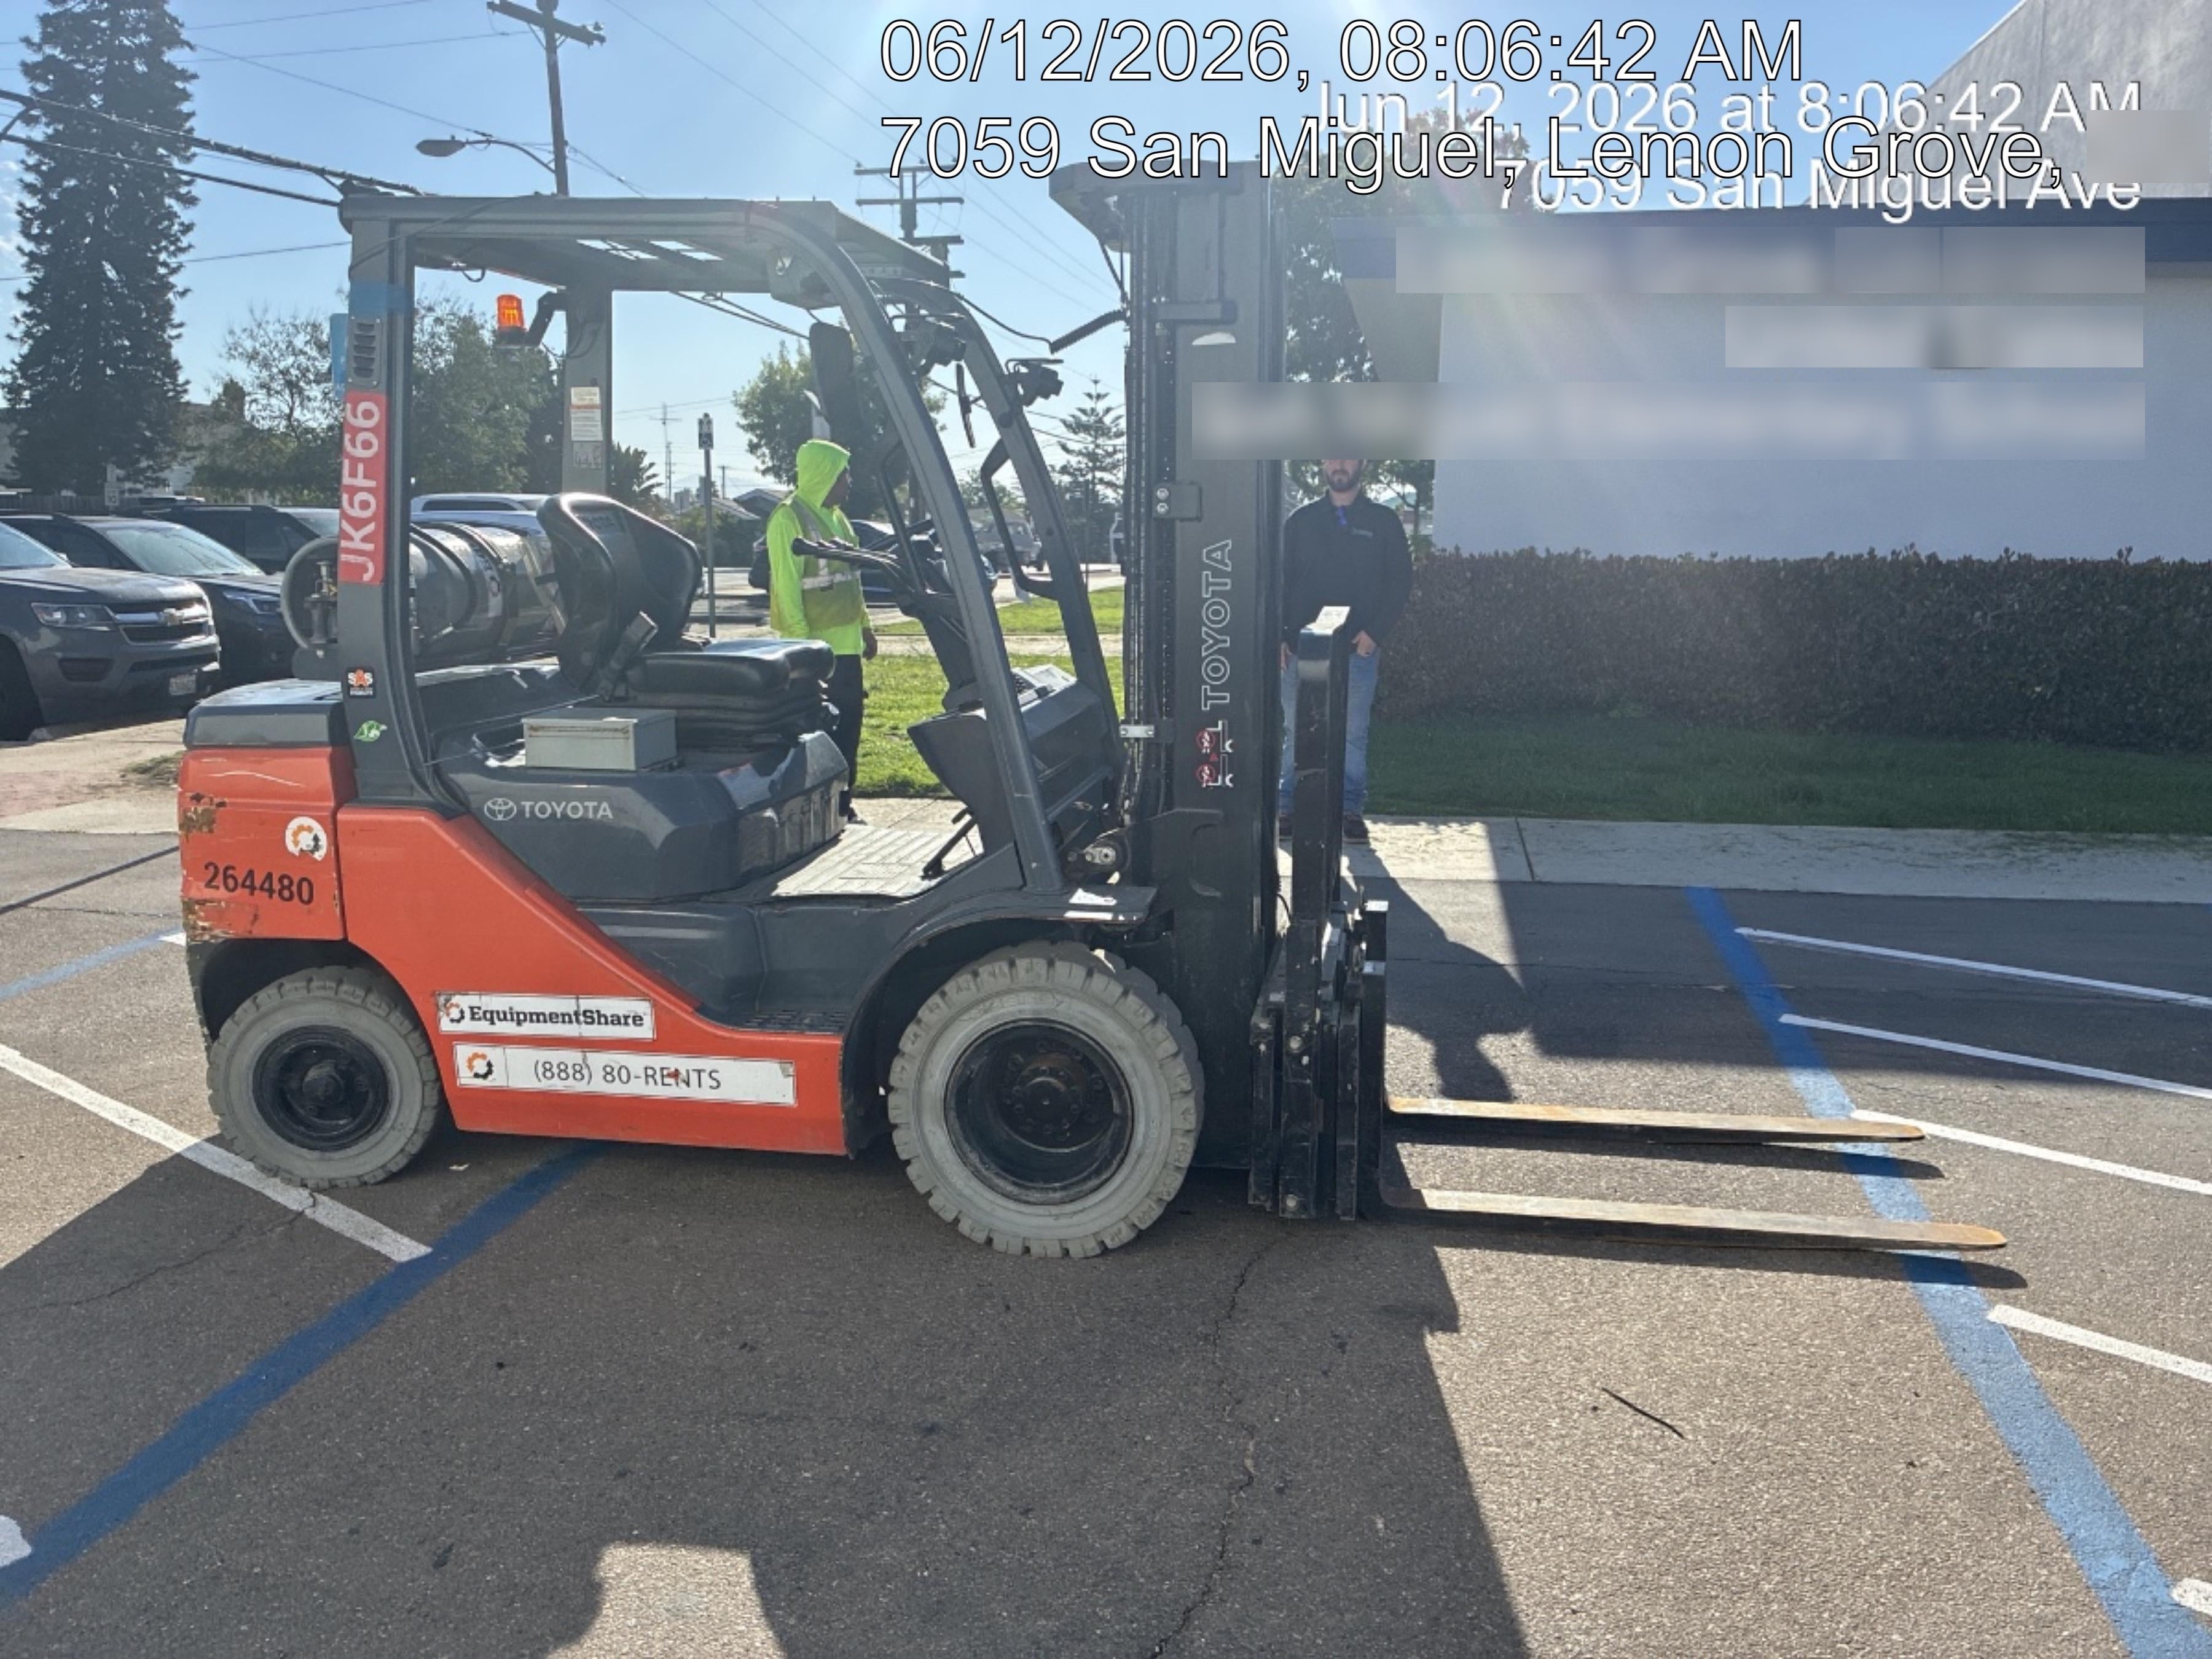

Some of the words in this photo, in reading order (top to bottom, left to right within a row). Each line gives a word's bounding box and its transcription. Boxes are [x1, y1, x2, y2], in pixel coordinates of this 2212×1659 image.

[340, 400, 380, 582] JK6F66
[1202, 539, 1232, 710] TOYOTA
[521, 801, 613, 820] TOYOTA
[204, 862, 315, 905] 264480
[469, 1006, 645, 1027] EquipmentShare
[533, 1059, 592, 1084] (888)
[602, 1064, 721, 1090] 80-RENTS
